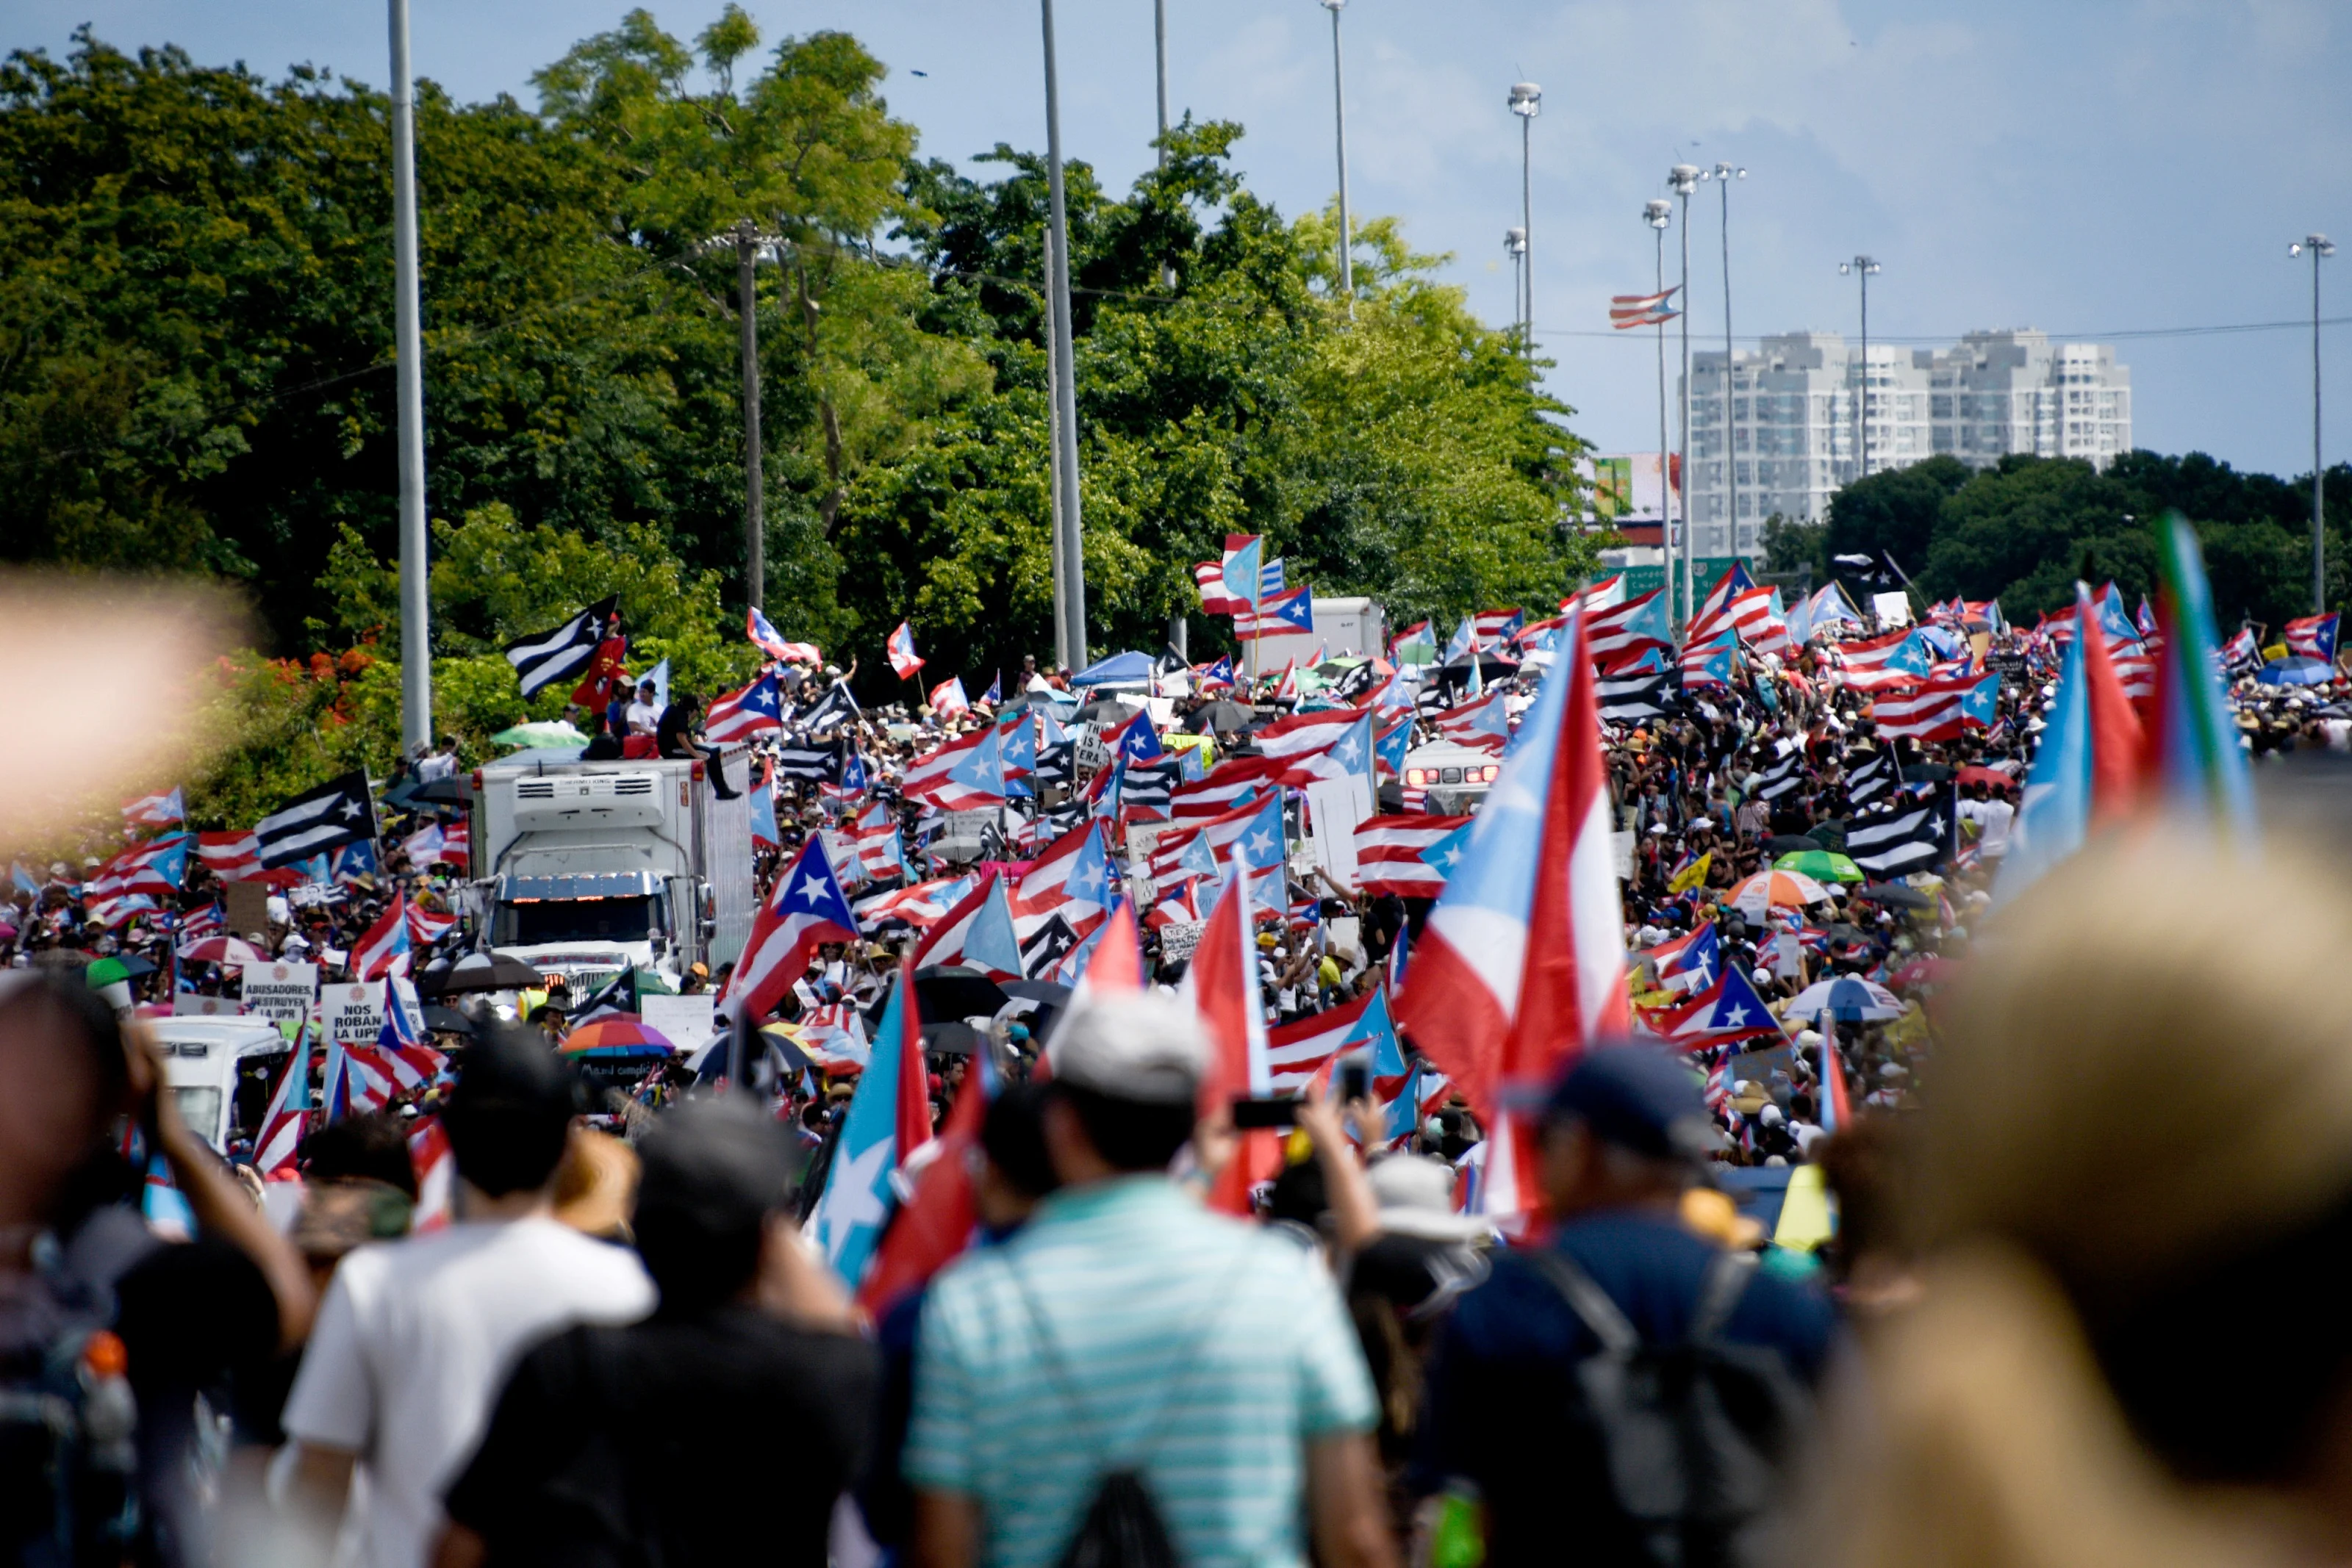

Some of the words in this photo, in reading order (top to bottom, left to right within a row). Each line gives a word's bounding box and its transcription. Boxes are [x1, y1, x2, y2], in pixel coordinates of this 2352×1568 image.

[1088, 722, 1110, 735] THI
[1083, 736, 1094, 747] IS
[246, 985, 312, 996] ABUSADORES,
[251, 997, 306, 1007] DESTRUYEN
[344, 1004, 371, 1015] NOS
[334, 1015, 381, 1028] ROBAN
[334, 1029, 349, 1039] LA
